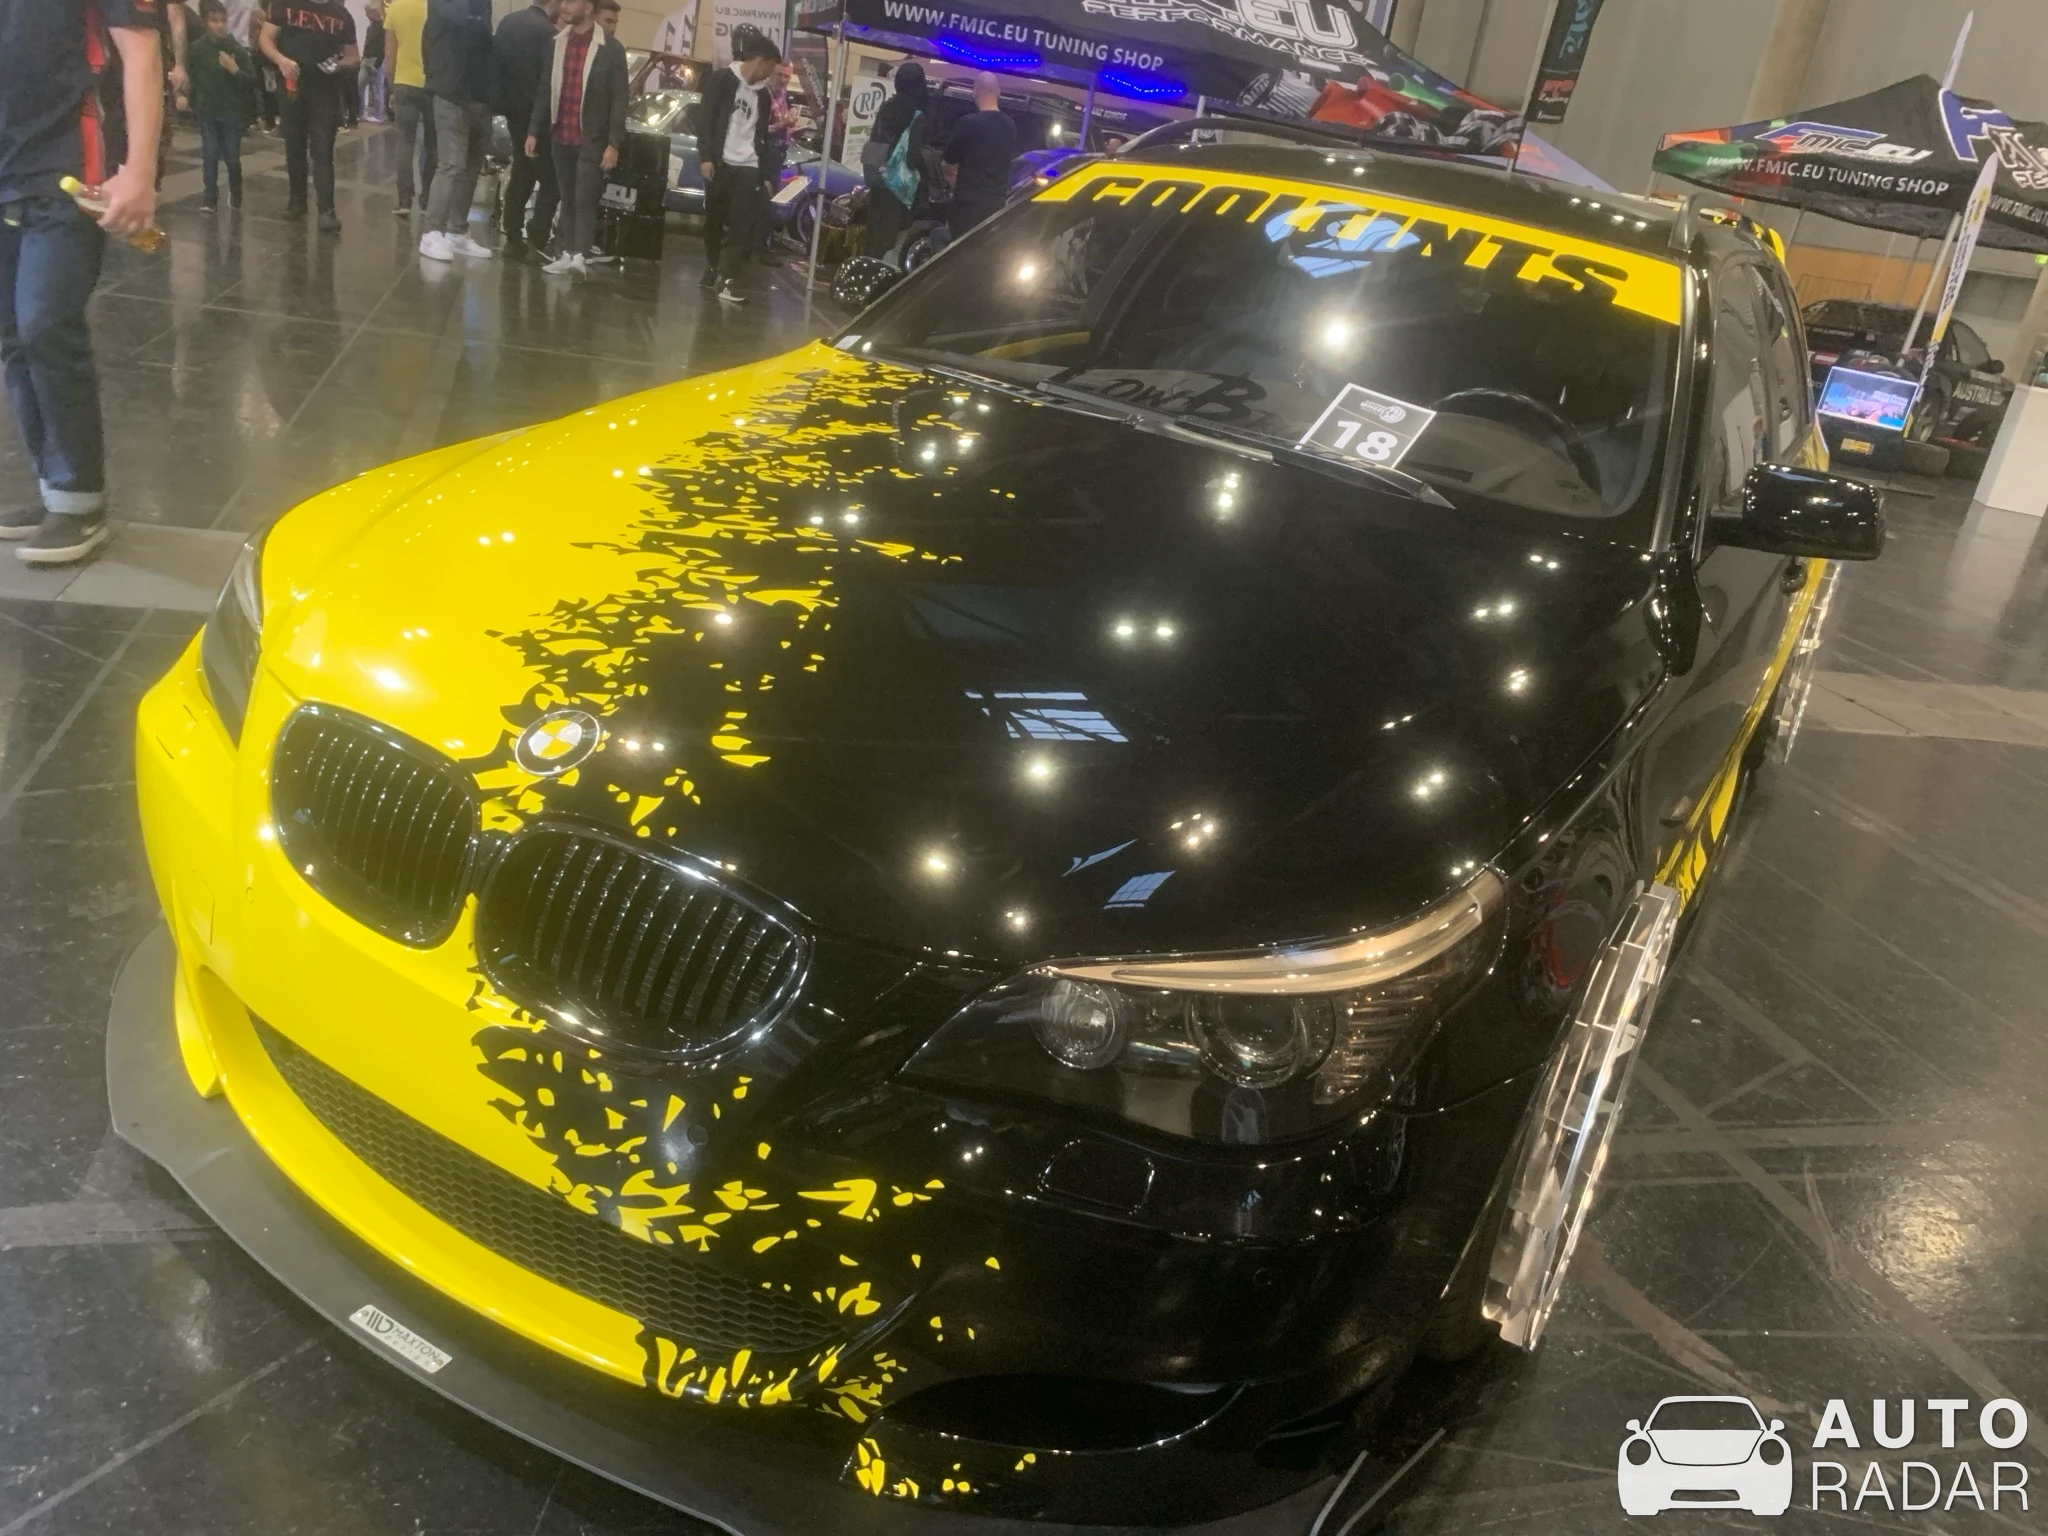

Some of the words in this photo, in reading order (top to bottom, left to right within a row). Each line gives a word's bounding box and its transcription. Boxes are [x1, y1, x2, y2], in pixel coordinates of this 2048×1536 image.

[884, 0, 1029, 43] WWW.FMIC.EU
[1033, 29, 1108, 61] TUNING
[1112, 47, 1164, 72] SHOP
[1082, 0, 1378, 66] PERFORMANCE
[1706, 155, 1824, 180] WWW.FMIC.EU
[1828, 166, 1894, 189] TUNING
[1896, 177, 1950, 196] SHOP
[1333, 420, 1398, 461] 18
[392, 1327, 441, 1360] MAXTON
